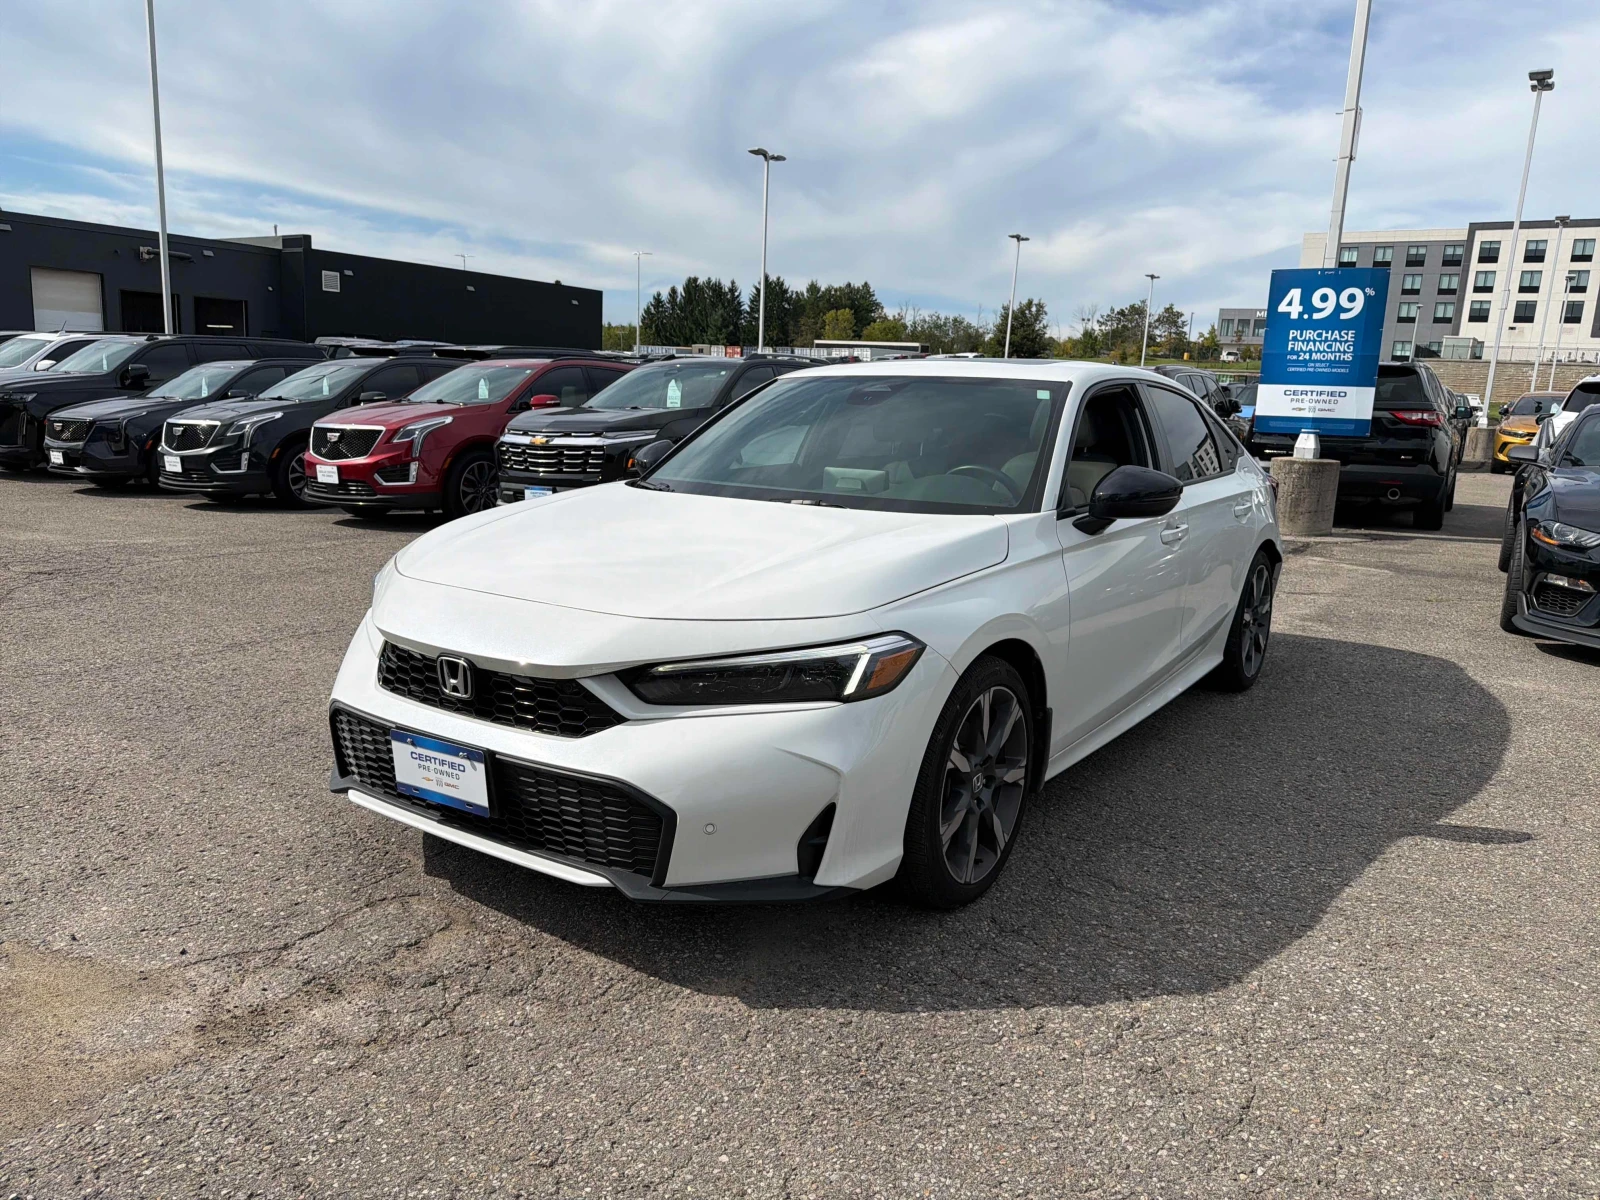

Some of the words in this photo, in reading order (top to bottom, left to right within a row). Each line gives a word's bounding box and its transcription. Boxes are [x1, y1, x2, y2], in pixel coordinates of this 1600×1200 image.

[1289, 329, 1356, 341] PURCHASE
[1287, 341, 1354, 352] FINANCING
[1298, 352, 1310, 360] 24
[1311, 352, 1353, 361] MONTHS
[1283, 389, 1347, 398] CERTIFIED
[1290, 397, 1339, 405] PRE-OWNED
[410, 751, 466, 773] CERTIFIED
[417, 763, 460, 781] PRE-OWNED
